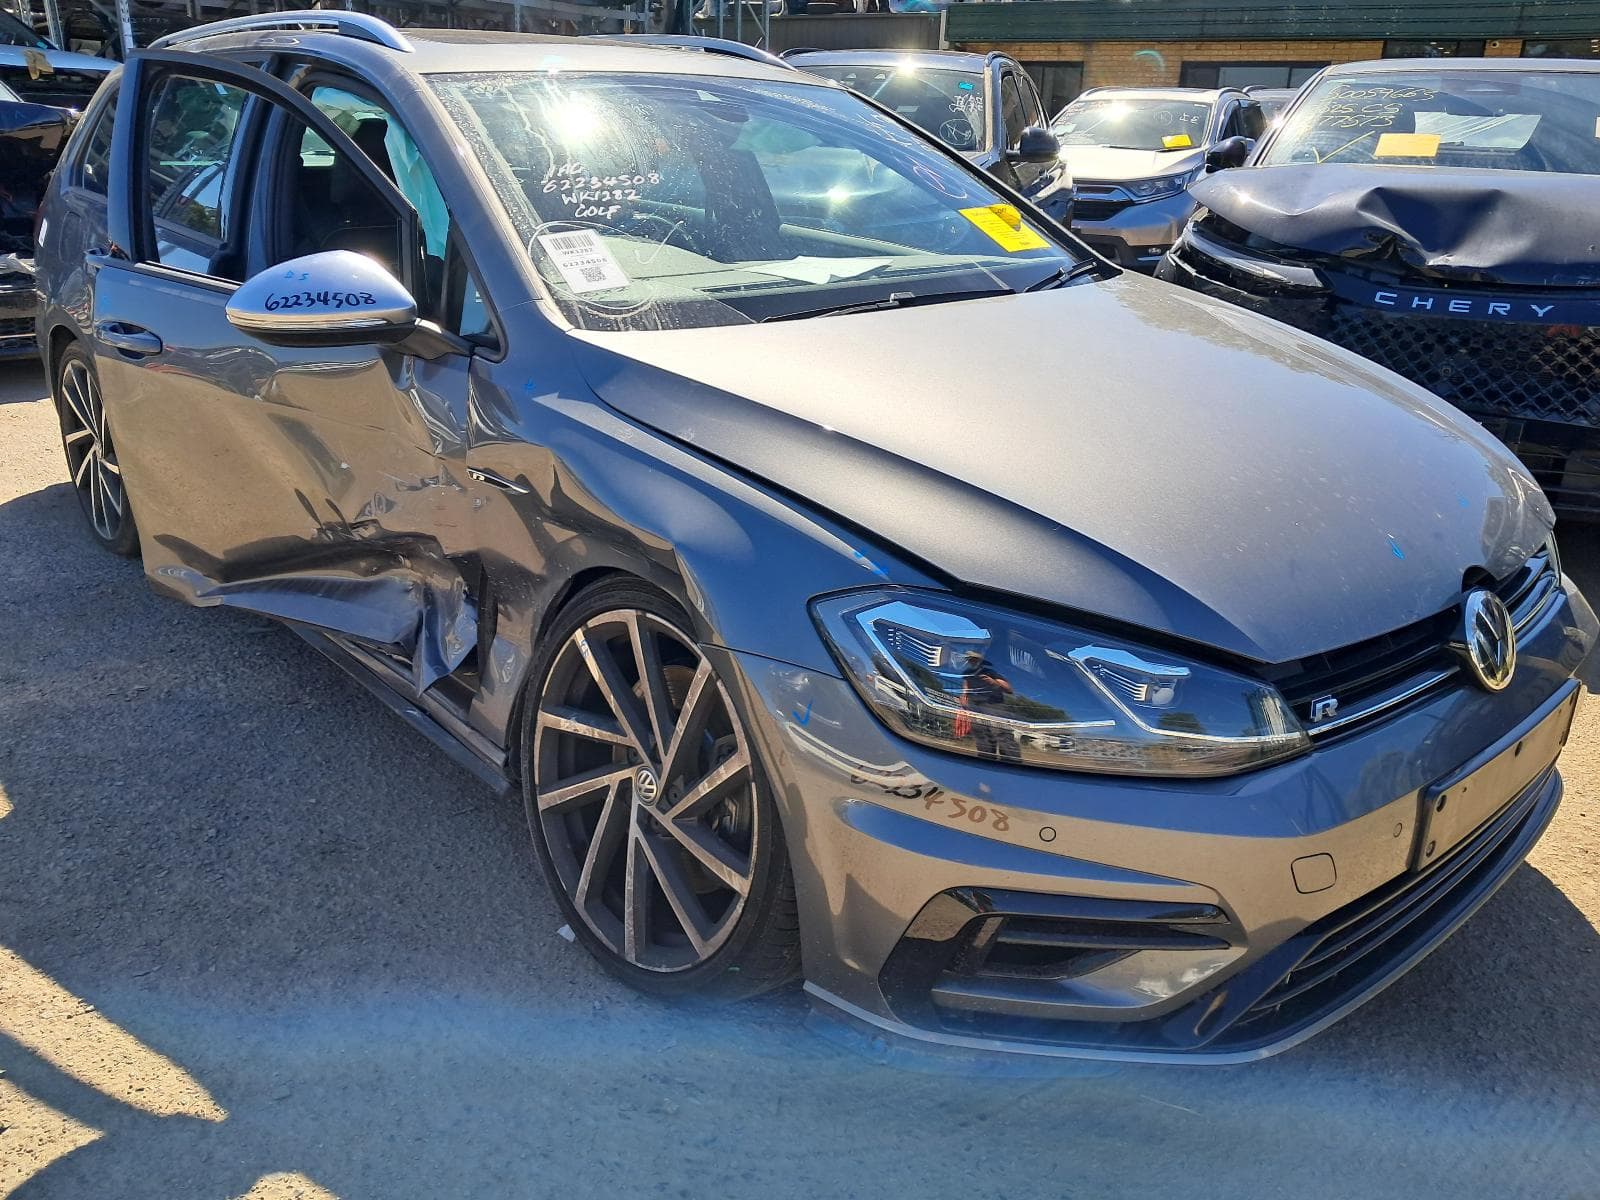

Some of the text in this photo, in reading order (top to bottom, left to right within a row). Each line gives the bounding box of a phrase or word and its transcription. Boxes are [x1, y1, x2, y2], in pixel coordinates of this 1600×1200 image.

[543, 172, 660, 193] 62234508
[575, 203, 621, 219] GOLF
[264, 290, 377, 312] 62234508
[1374, 290, 1555, 318] CHERY
